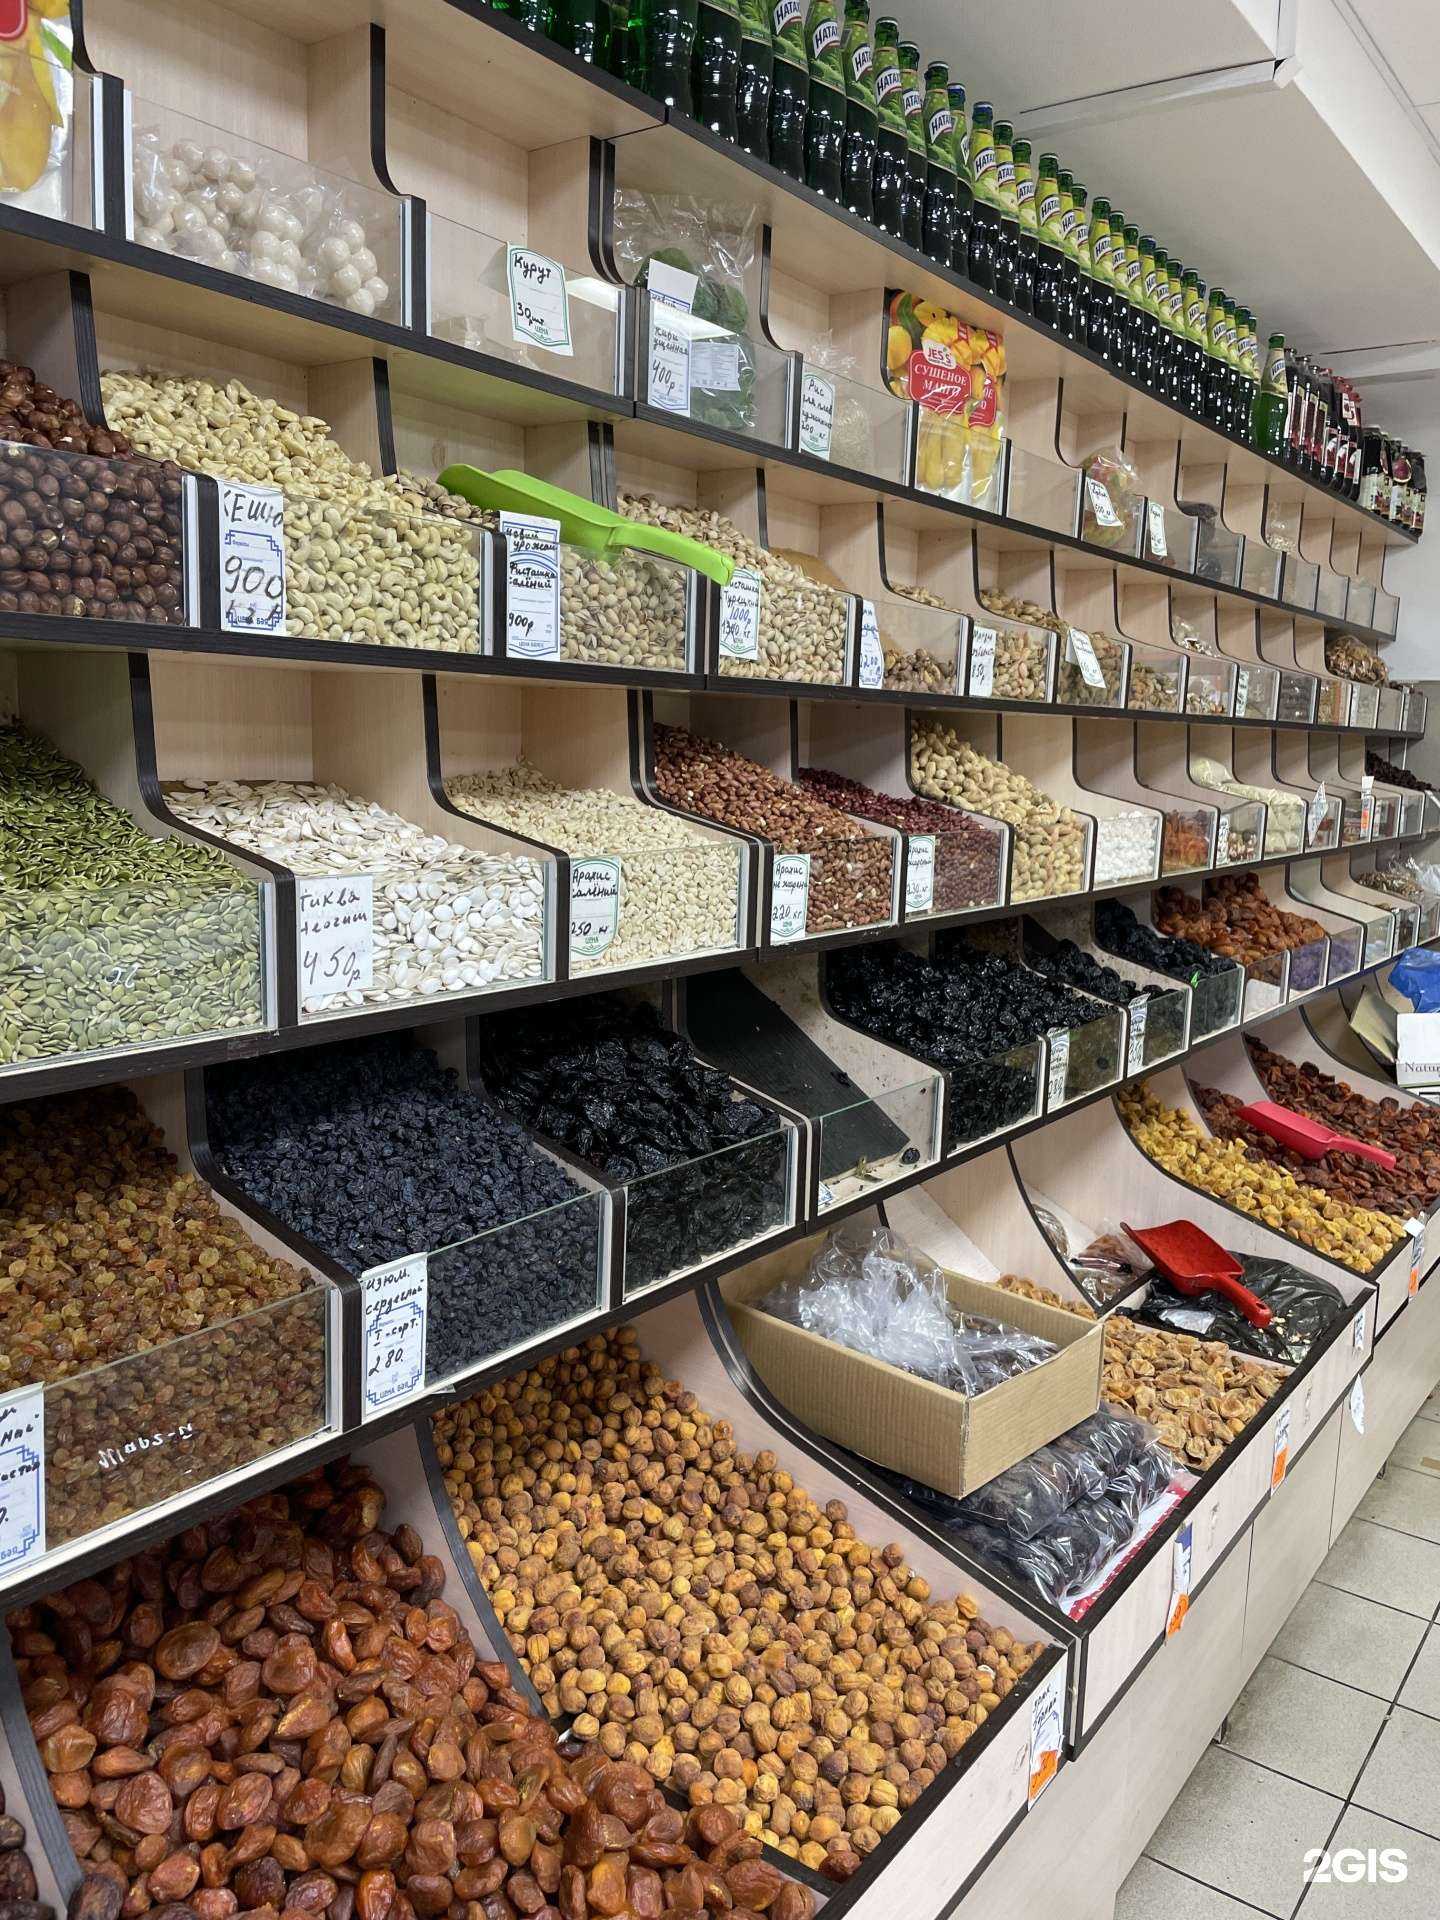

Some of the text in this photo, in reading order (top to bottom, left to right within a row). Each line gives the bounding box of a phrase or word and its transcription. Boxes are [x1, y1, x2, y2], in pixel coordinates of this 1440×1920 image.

[514, 253, 552, 284] Курут
[914, 363, 968, 387] СУШЕНОЕ
[225, 555, 284, 600] 900
[572, 868, 611, 887] Арахис
